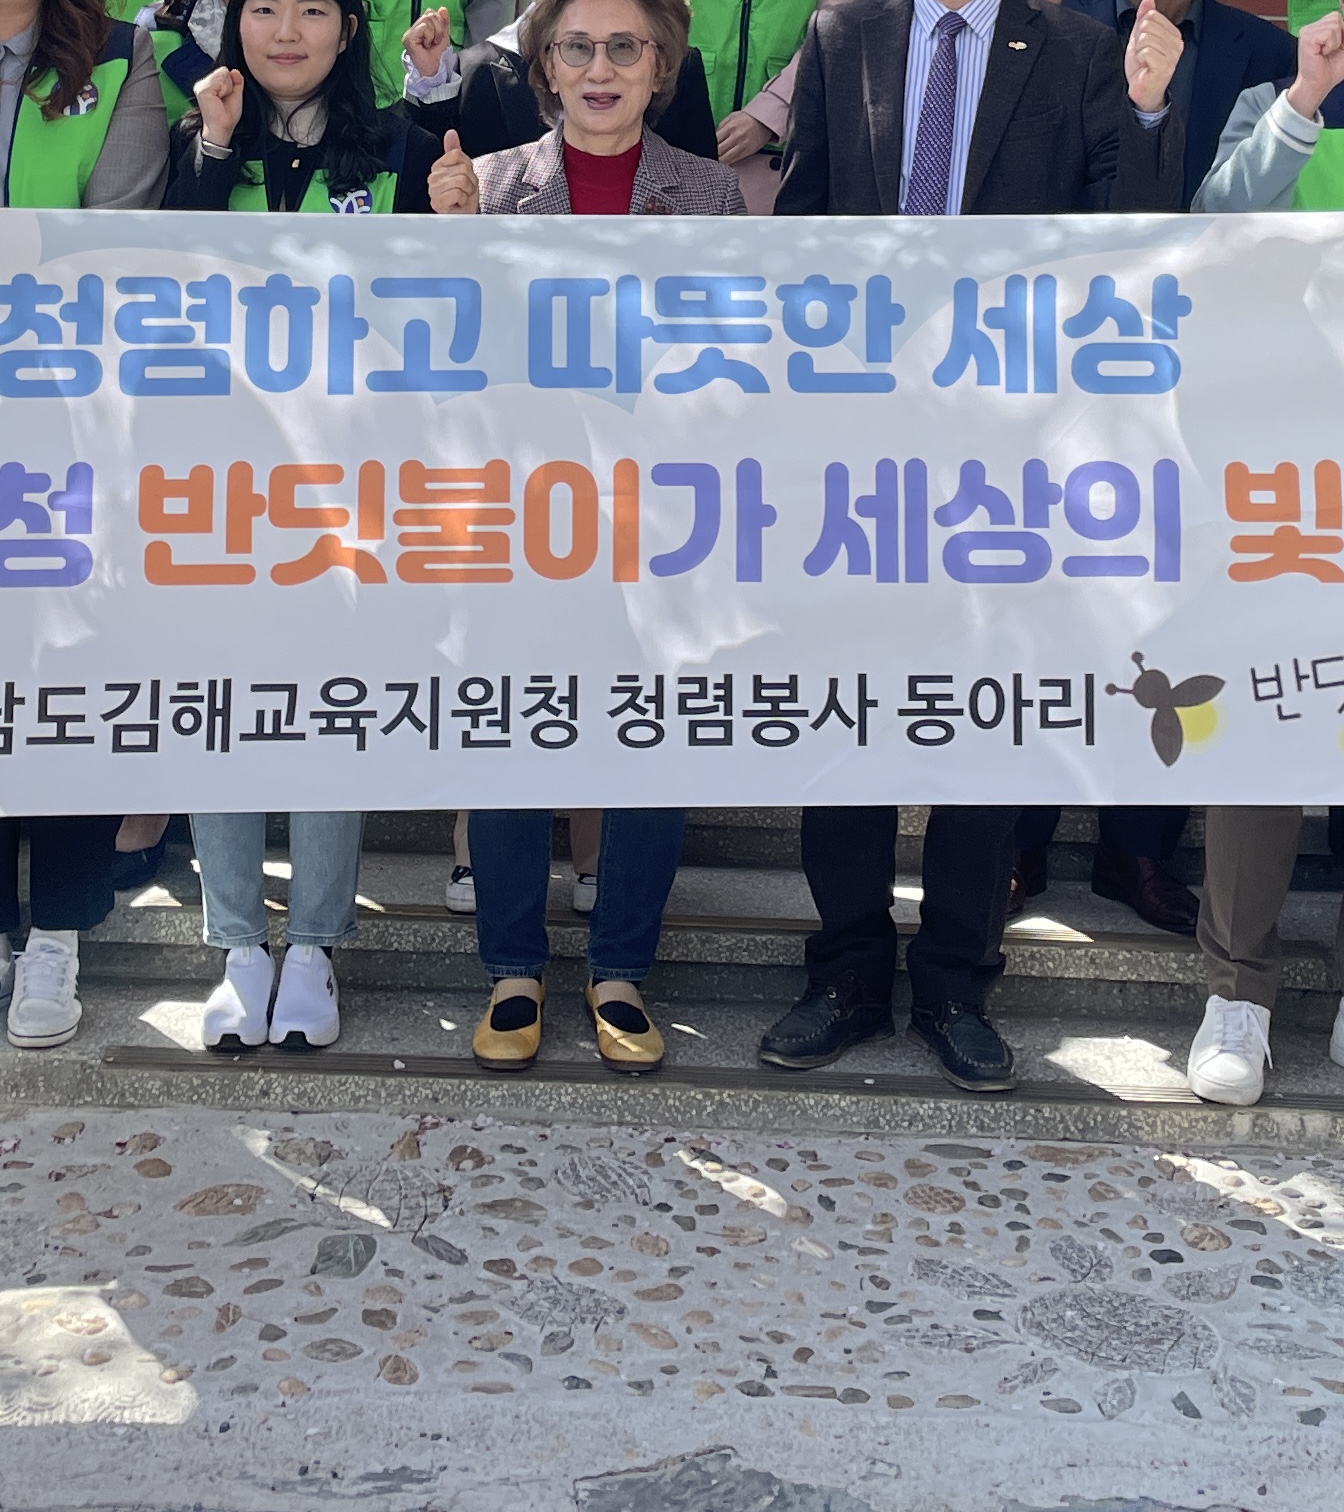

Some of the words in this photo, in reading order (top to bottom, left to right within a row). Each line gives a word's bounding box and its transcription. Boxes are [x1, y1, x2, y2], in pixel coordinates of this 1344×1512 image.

[527, 274, 906, 395] 따뜻한
[932, 274, 1192, 394] 세상
[139, 457, 777, 586] 반딧불이가
[803, 458, 1181, 584] 세상의
[605, 673, 879, 749] 청렴봉사
[896, 671, 1096, 747] 동아리
